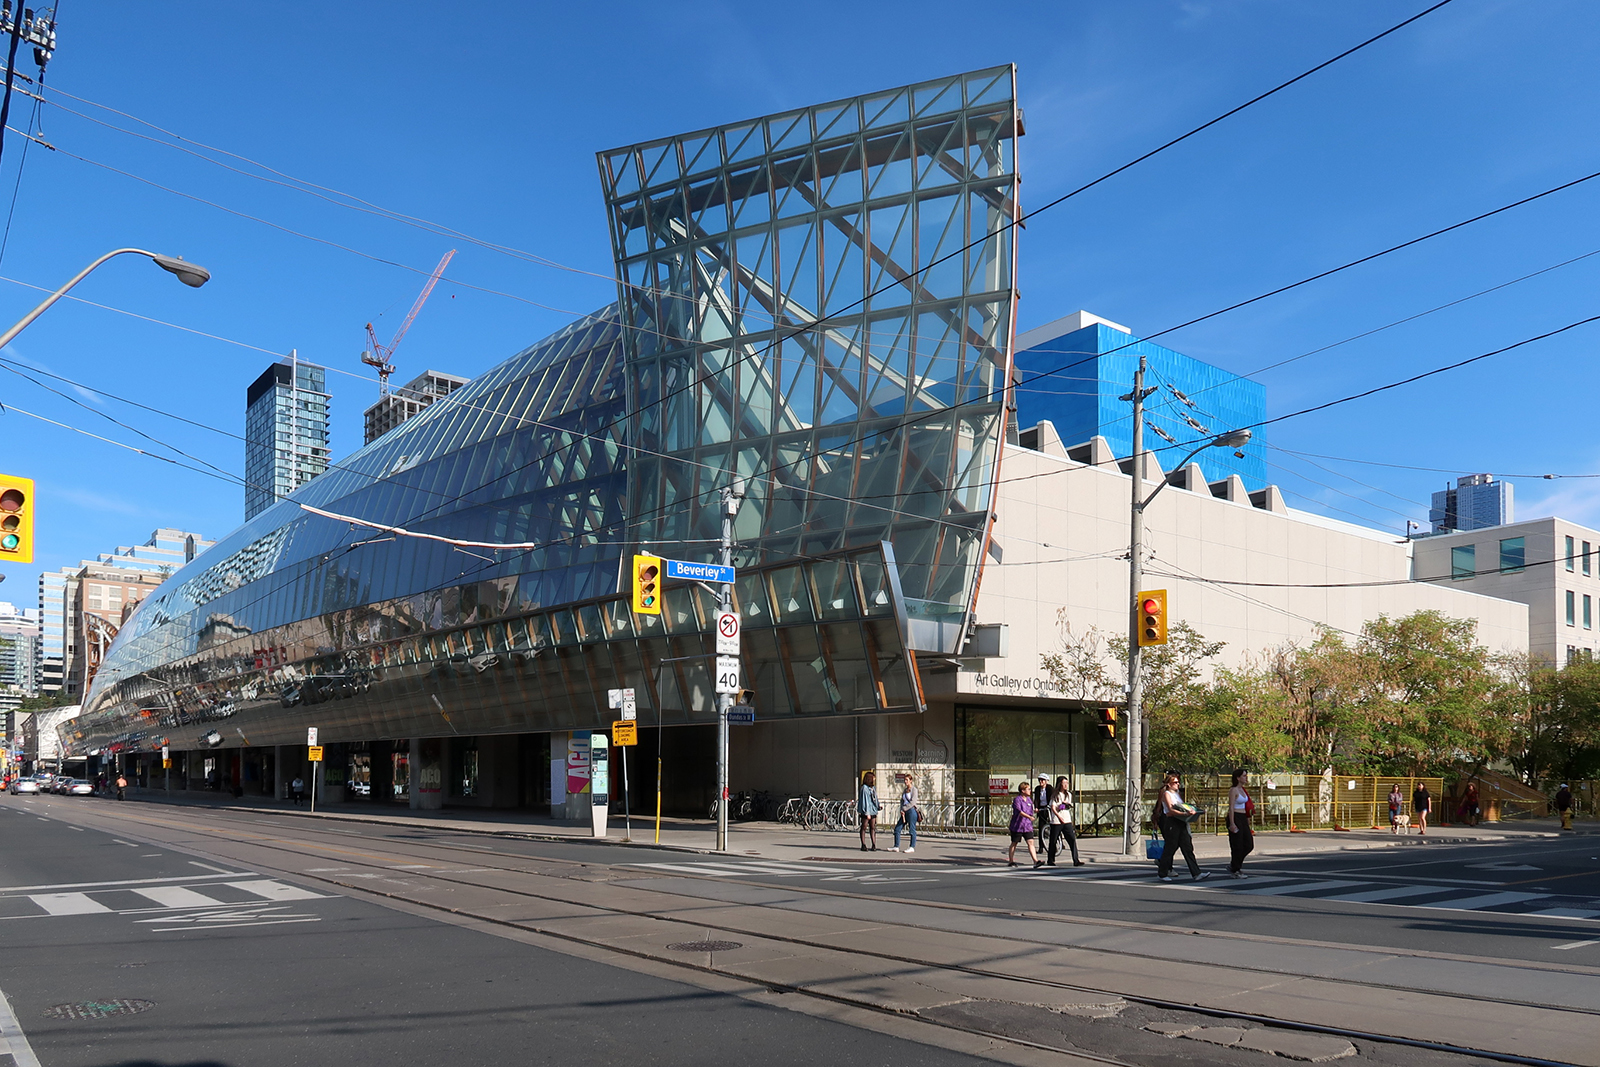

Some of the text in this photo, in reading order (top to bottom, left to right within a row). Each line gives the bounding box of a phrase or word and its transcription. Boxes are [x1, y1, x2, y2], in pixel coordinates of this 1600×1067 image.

[677, 563, 719, 580] Beverley
[718, 673, 737, 688] 40
[976, 673, 988, 686] Art
[990, 674, 1022, 691] Gallery
[1022, 677, 1031, 689] of
[568, 738, 590, 779] AGO
[917, 749, 945, 758] learning
[325, 768, 344, 781] AGO
[420, 768, 441, 784] AGO
